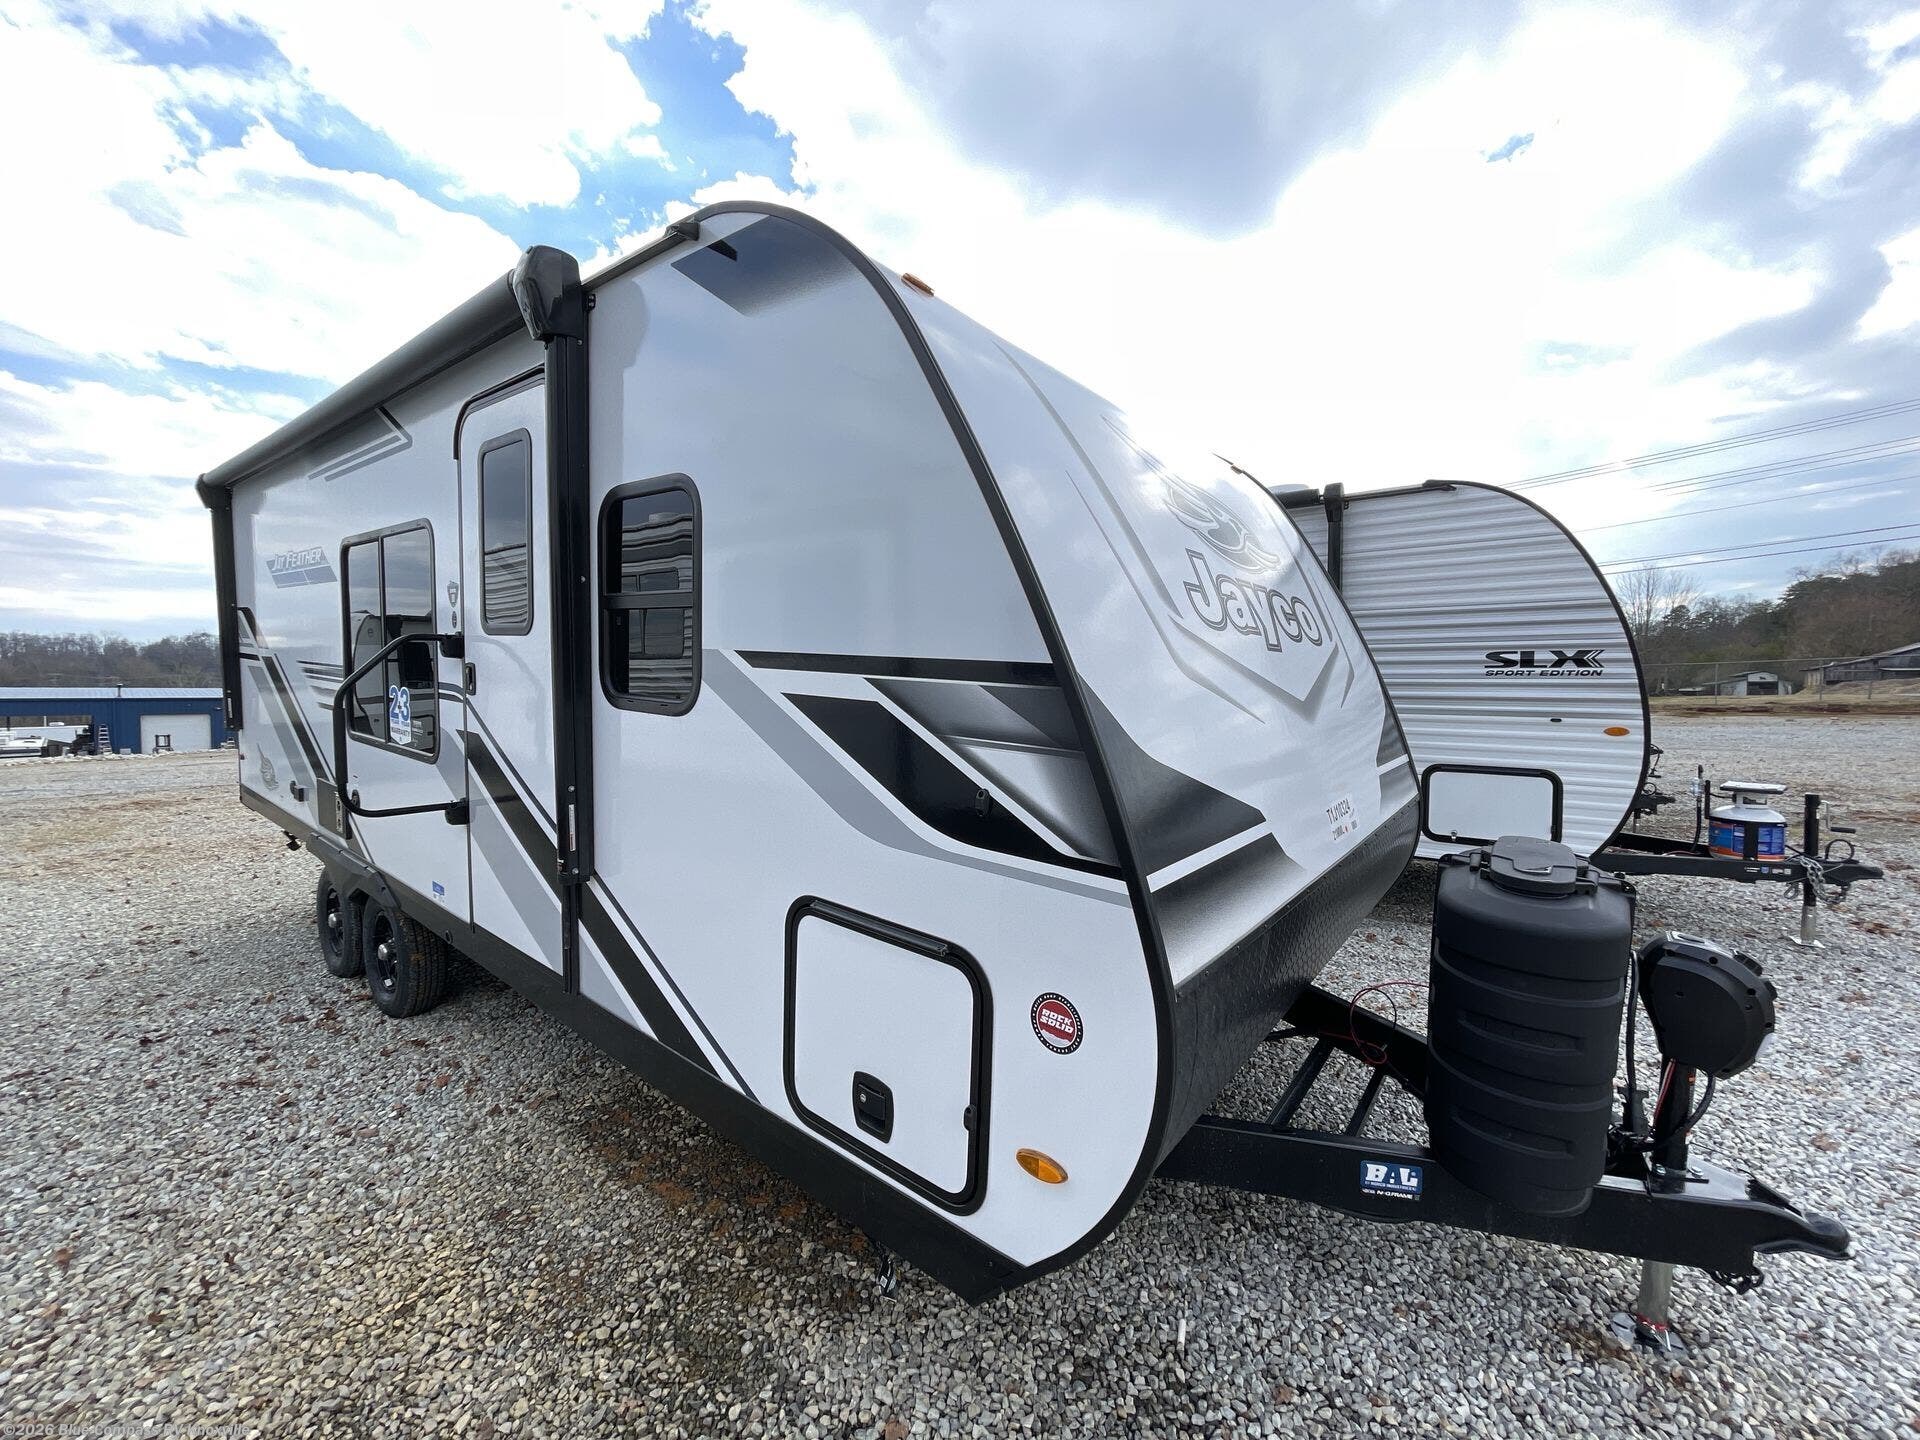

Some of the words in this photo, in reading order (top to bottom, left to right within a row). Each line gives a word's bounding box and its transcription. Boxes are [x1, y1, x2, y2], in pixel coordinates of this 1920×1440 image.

[286, 548, 322, 567] FEATHER
[1183, 548, 1322, 653] Jayco
[1484, 650, 1604, 668] SLX
[1040, 1015, 1074, 1034] SOLID
[1042, 1008, 1073, 1025] ROCK
[1365, 1163, 1418, 1187] BAL
